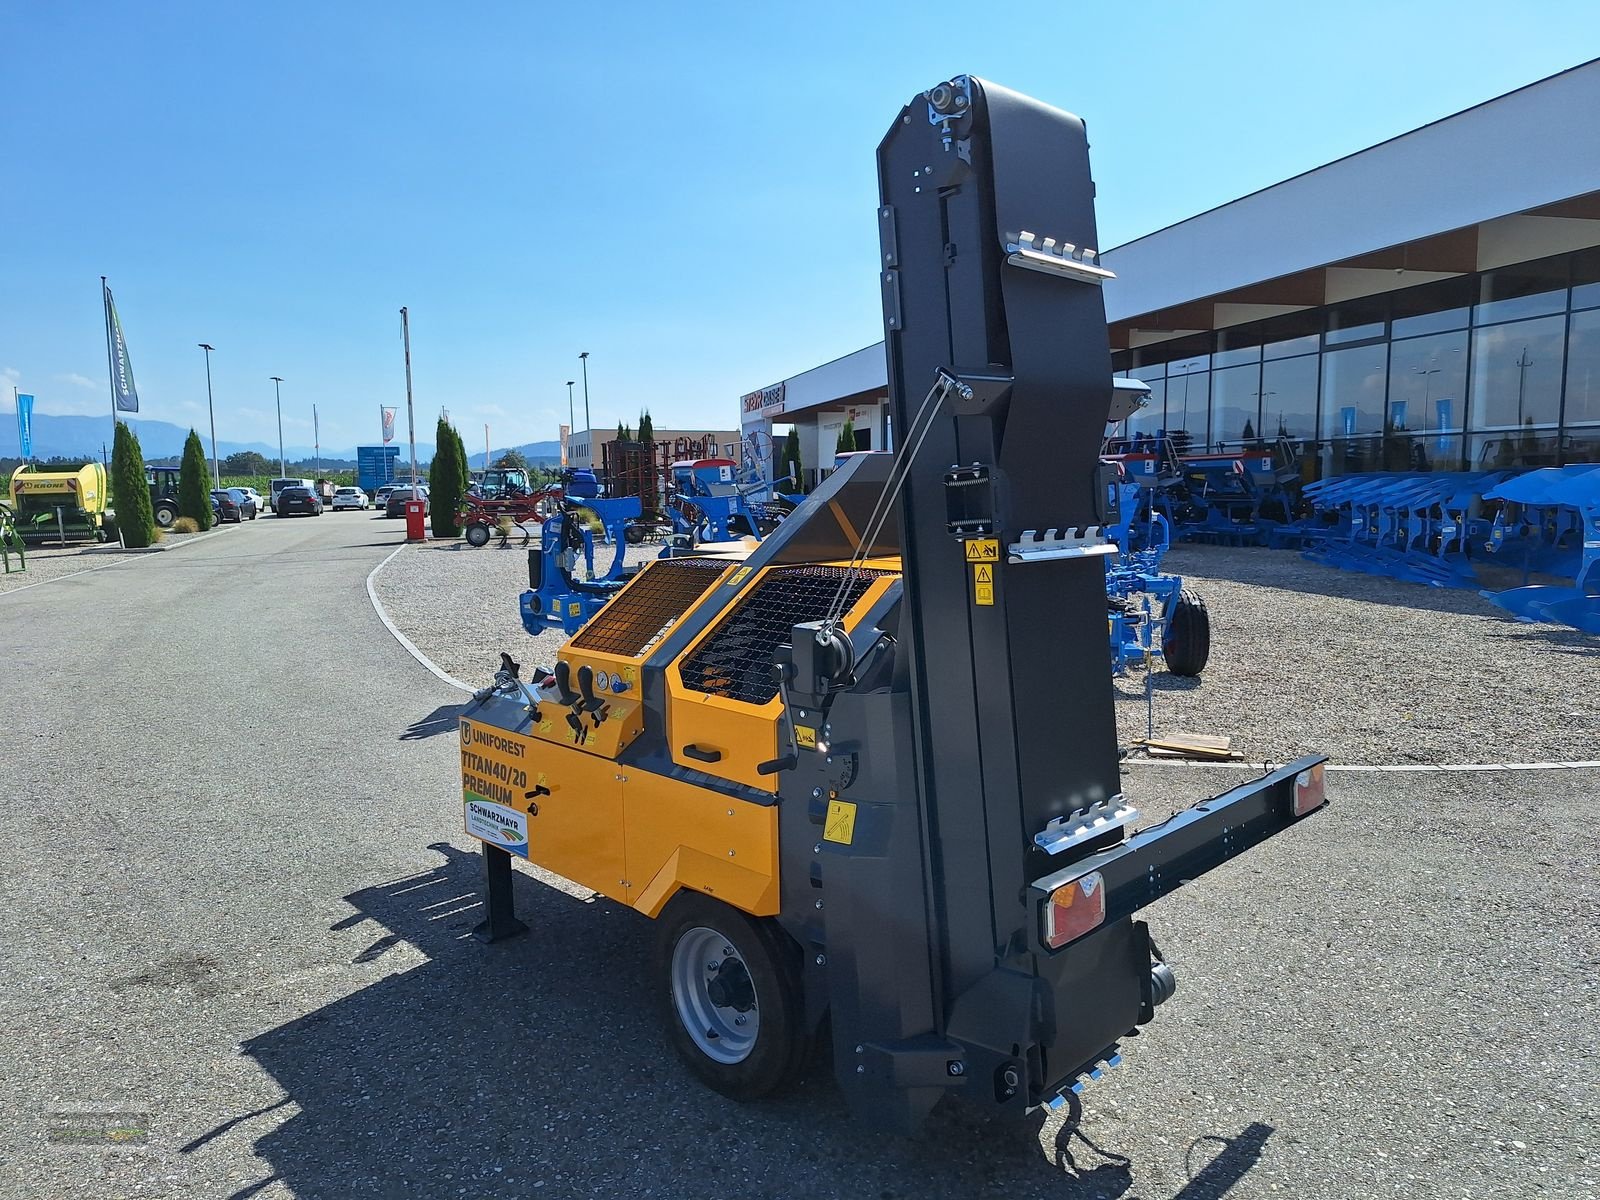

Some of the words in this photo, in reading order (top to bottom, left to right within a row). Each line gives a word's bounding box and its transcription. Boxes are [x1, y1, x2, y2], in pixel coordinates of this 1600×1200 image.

[472, 728, 526, 758] UNIFOREST
[463, 772, 512, 807] PREMIUM
[470, 802, 519, 831] SCHWARZMAYR
